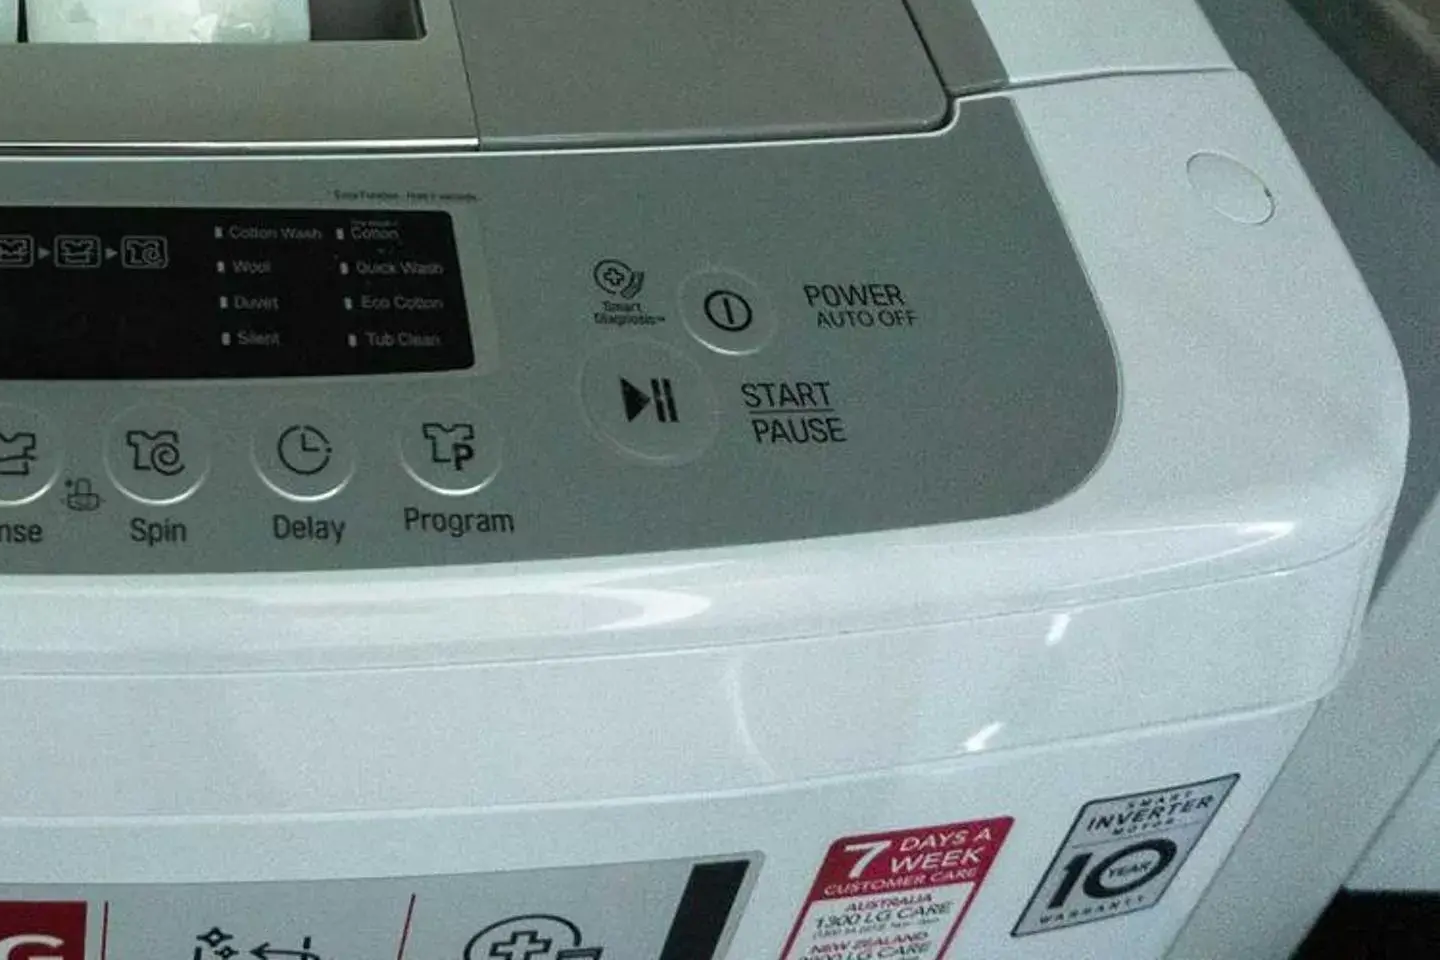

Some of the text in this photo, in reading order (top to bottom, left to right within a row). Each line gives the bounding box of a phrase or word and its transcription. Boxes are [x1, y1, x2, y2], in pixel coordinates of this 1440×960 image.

[803, 283, 906, 308] POWER
[817, 309, 918, 328] AUTO OFF
[367, 332, 394, 347] Tub
[741, 381, 831, 408] START
[752, 417, 848, 444] PAUSE
[129, 517, 188, 545] Spin
[272, 514, 346, 544] Delay
[403, 506, 516, 538] Program
[1087, 795, 1214, 831] INVERTER
[900, 827, 992, 852] DAYS A
[843, 839, 892, 879] 7
[891, 846, 985, 873] WEEK
[824, 868, 978, 897] CUSTOMER CARE
[1048, 838, 1177, 909] 10
